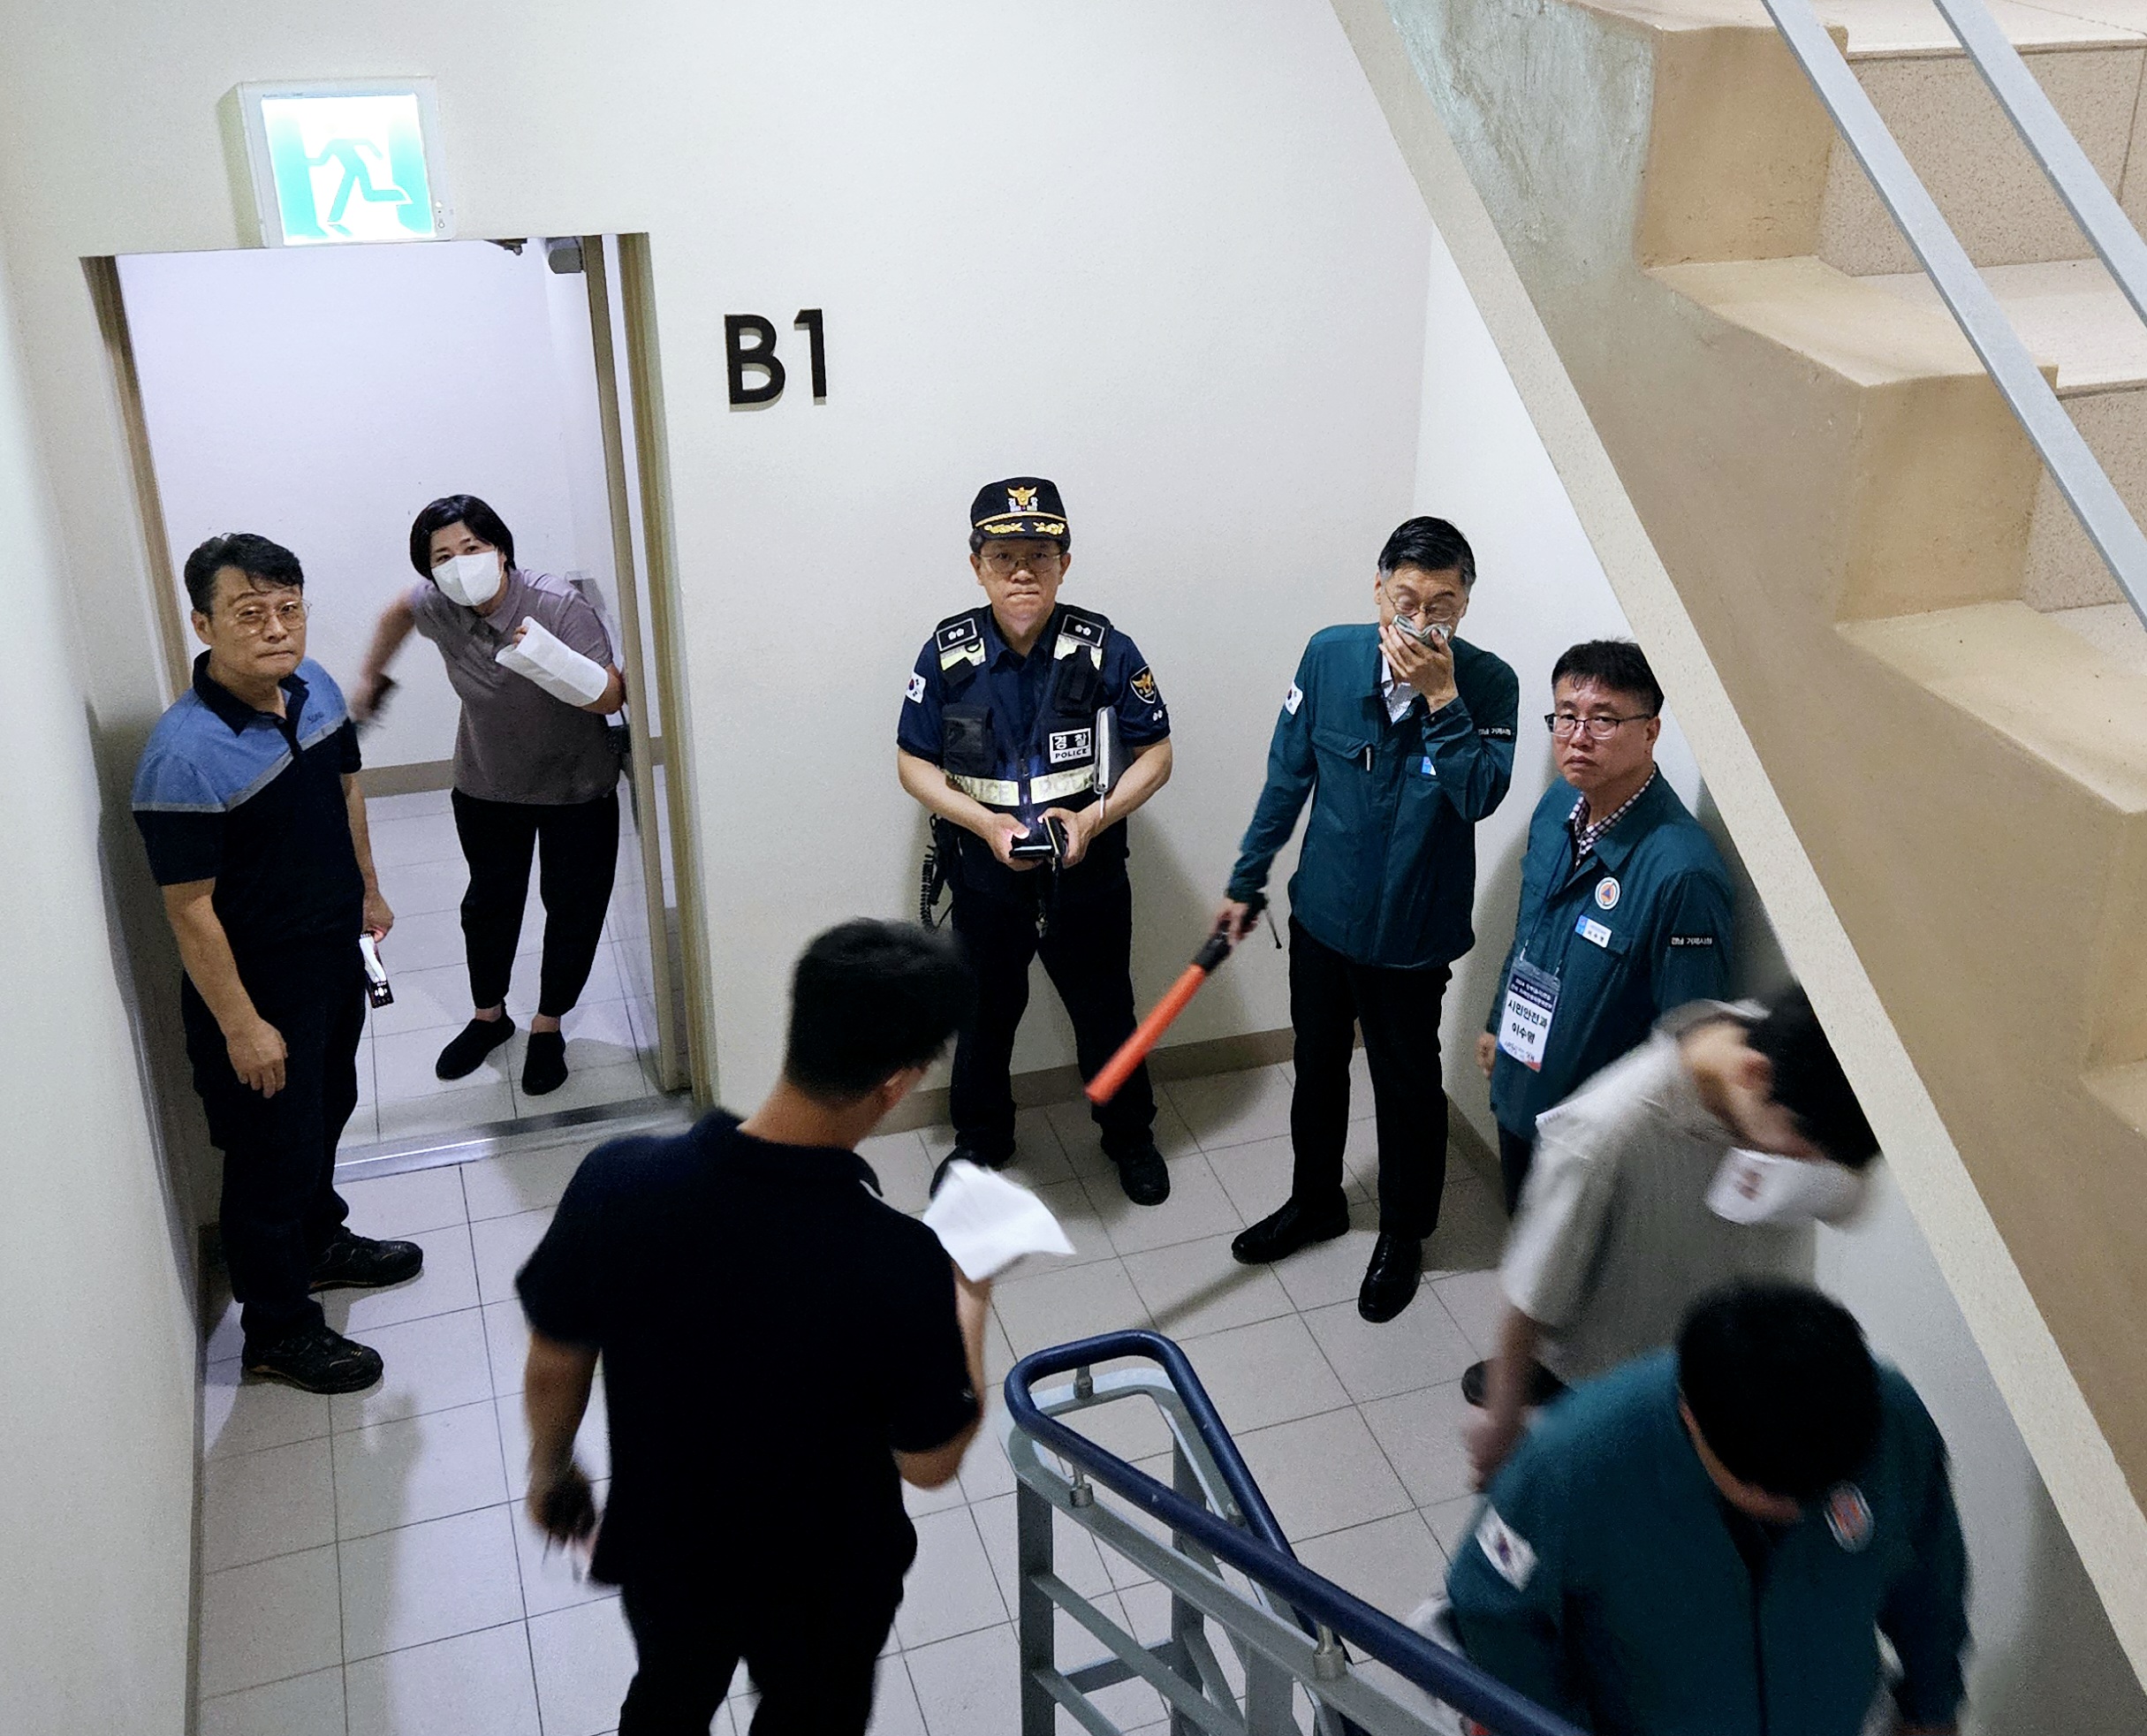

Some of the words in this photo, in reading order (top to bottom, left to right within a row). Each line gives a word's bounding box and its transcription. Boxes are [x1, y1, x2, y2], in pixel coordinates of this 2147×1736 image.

[725, 307, 827, 409] B1
[1055, 748, 1088, 759] POLICE
[1507, 999, 1548, 1029] 시민안전과
